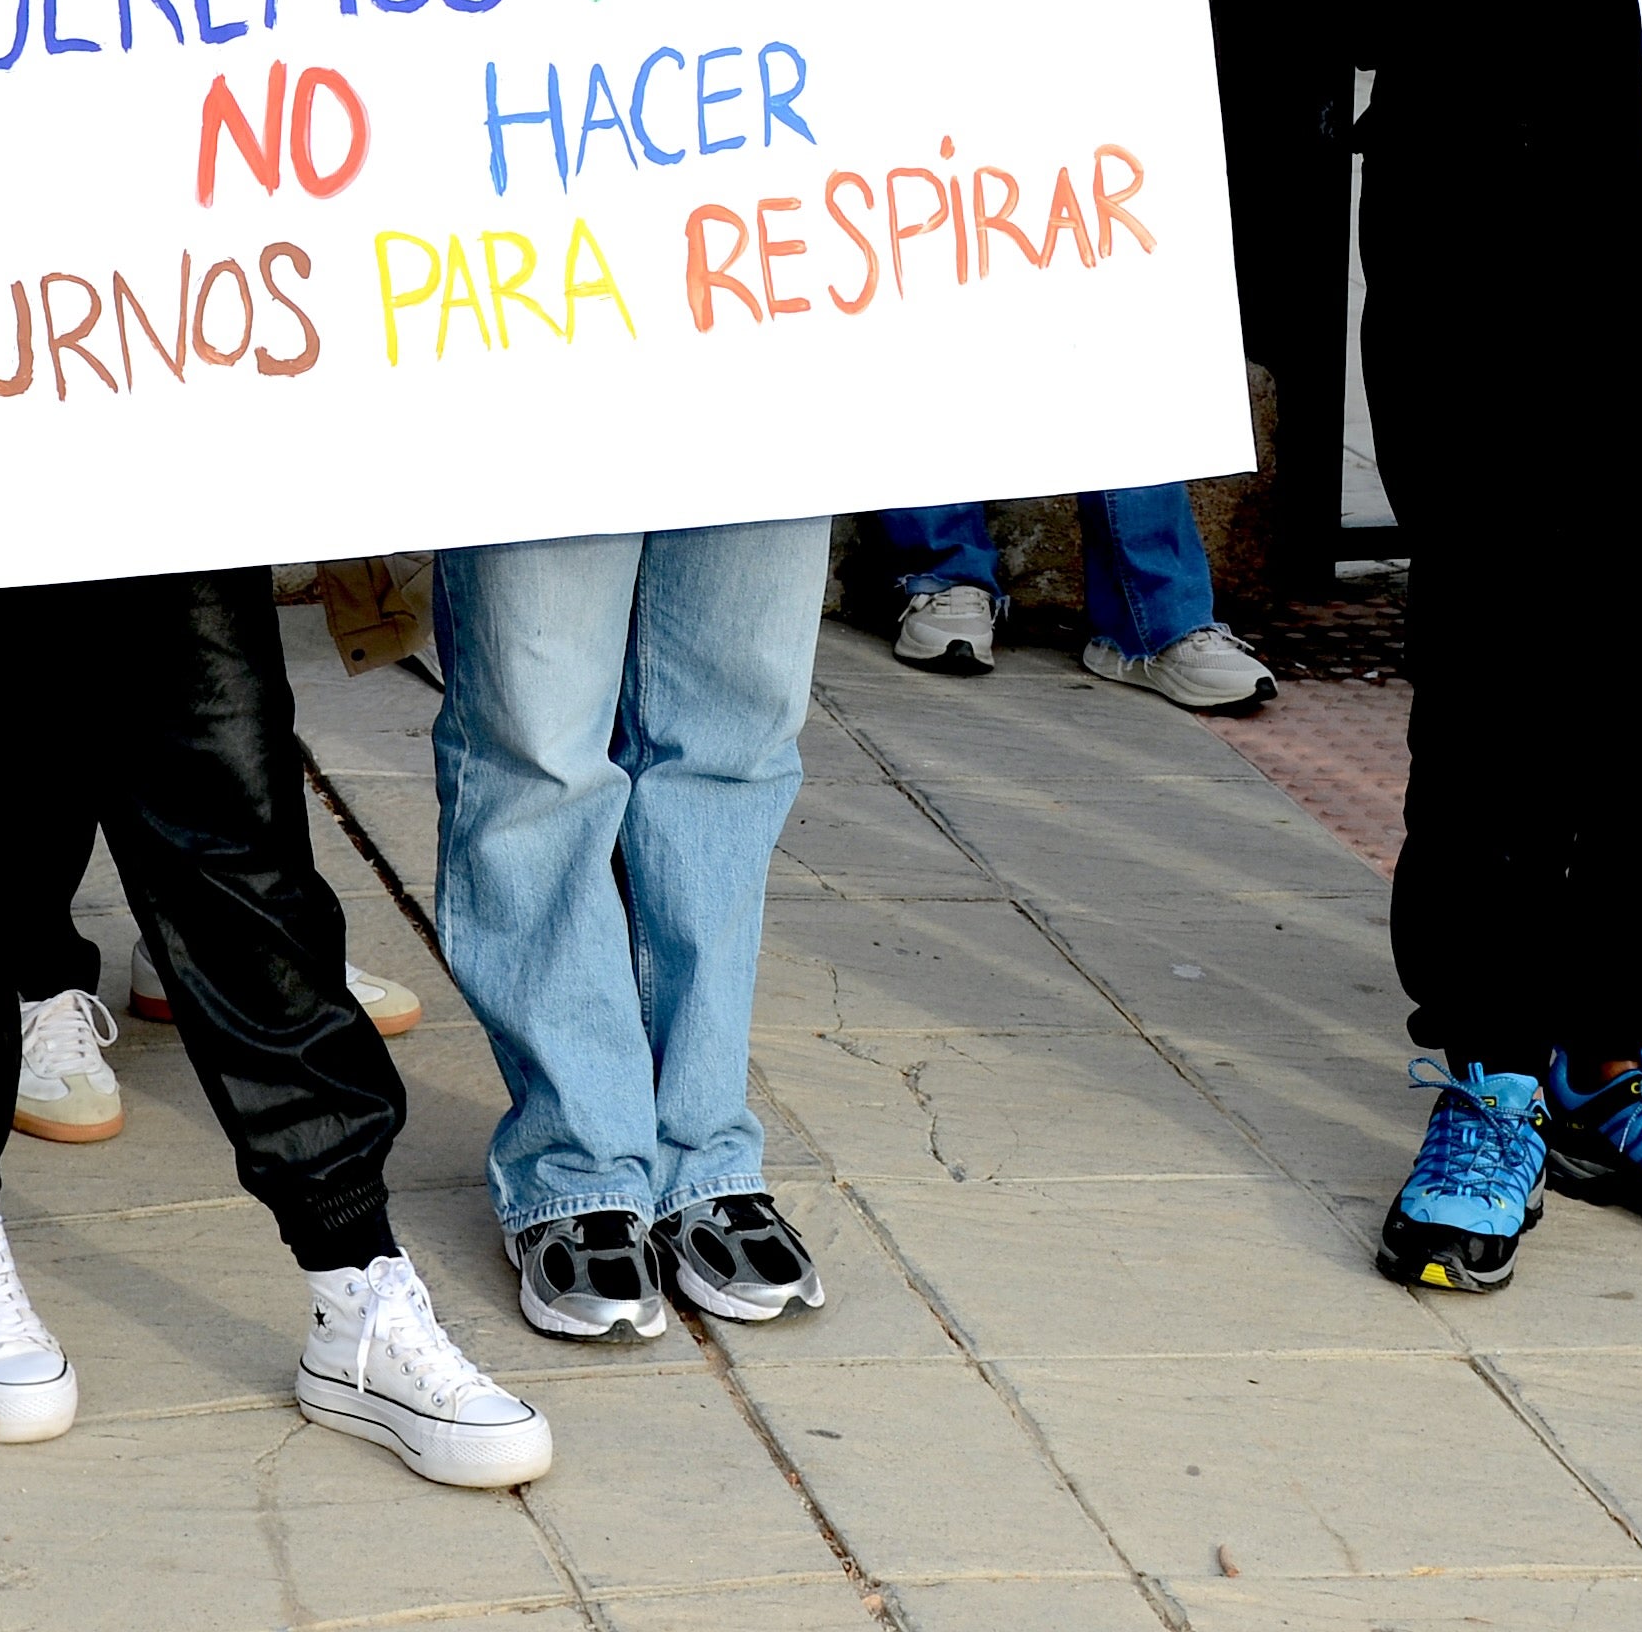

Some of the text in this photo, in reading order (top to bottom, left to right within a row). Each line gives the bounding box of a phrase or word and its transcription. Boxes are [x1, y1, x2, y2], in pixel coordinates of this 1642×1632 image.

[197, 41, 816, 207] NO HACER
[374, 218, 636, 367] PARA
[685, 136, 1155, 333] RESPIRAR
